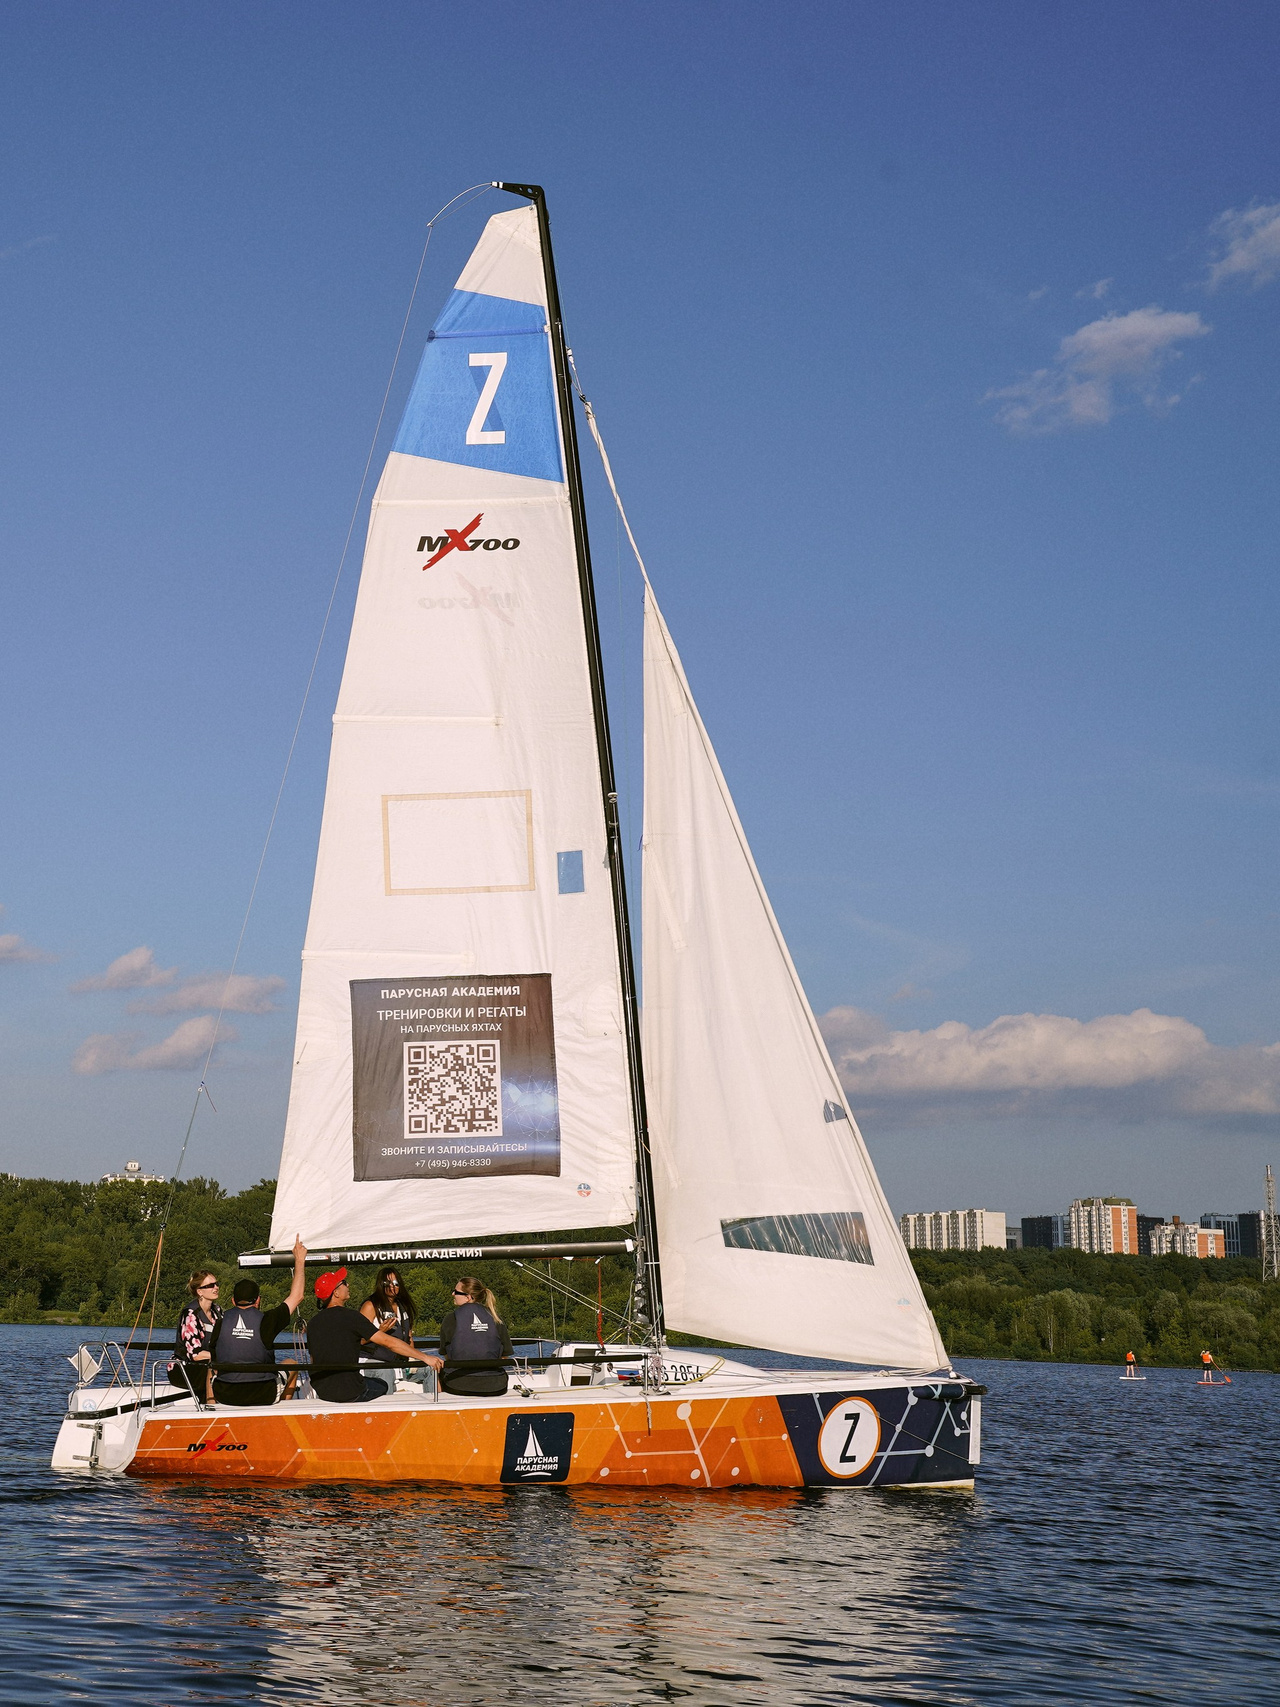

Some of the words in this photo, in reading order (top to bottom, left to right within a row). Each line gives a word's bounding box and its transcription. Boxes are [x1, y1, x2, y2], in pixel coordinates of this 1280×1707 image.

[466, 352, 507, 445] Z
[417, 513, 520, 571] MX700
[381, 987, 448, 999] ПАРУСНАЯ
[451, 985, 520, 997] АКАДЕМИЯ
[377, 1007, 462, 1021] ТРЕНИРОВКИ
[465, 1007, 474, 1018] И
[478, 1006, 527, 1018] РЕГАТЫ
[400, 1025, 414, 1034] НА
[416, 1023, 470, 1033] ПАРУСНЫХ
[472, 1023, 502, 1032] ЯХТАХ
[381, 1146, 426, 1156] ЗВОНИТЕ
[427, 1145, 435, 1154] И
[437, 1142, 527, 1154] ЗАПИСЫВАЙТЕСЬ!
[415, 1159, 426, 1168] +7
[427, 1159, 450, 1170] (495)
[452, 1158, 492, 1168] 946-8330
[347, 1250, 411, 1262] ПАРУСНАЯ
[415, 1248, 482, 1260] АКАДЕМИЯ
[839, 1412, 860, 1463] Z
[187, 1430, 248, 1461] MX700
[517, 1456, 558, 1464] ПАРУСНАЯ
